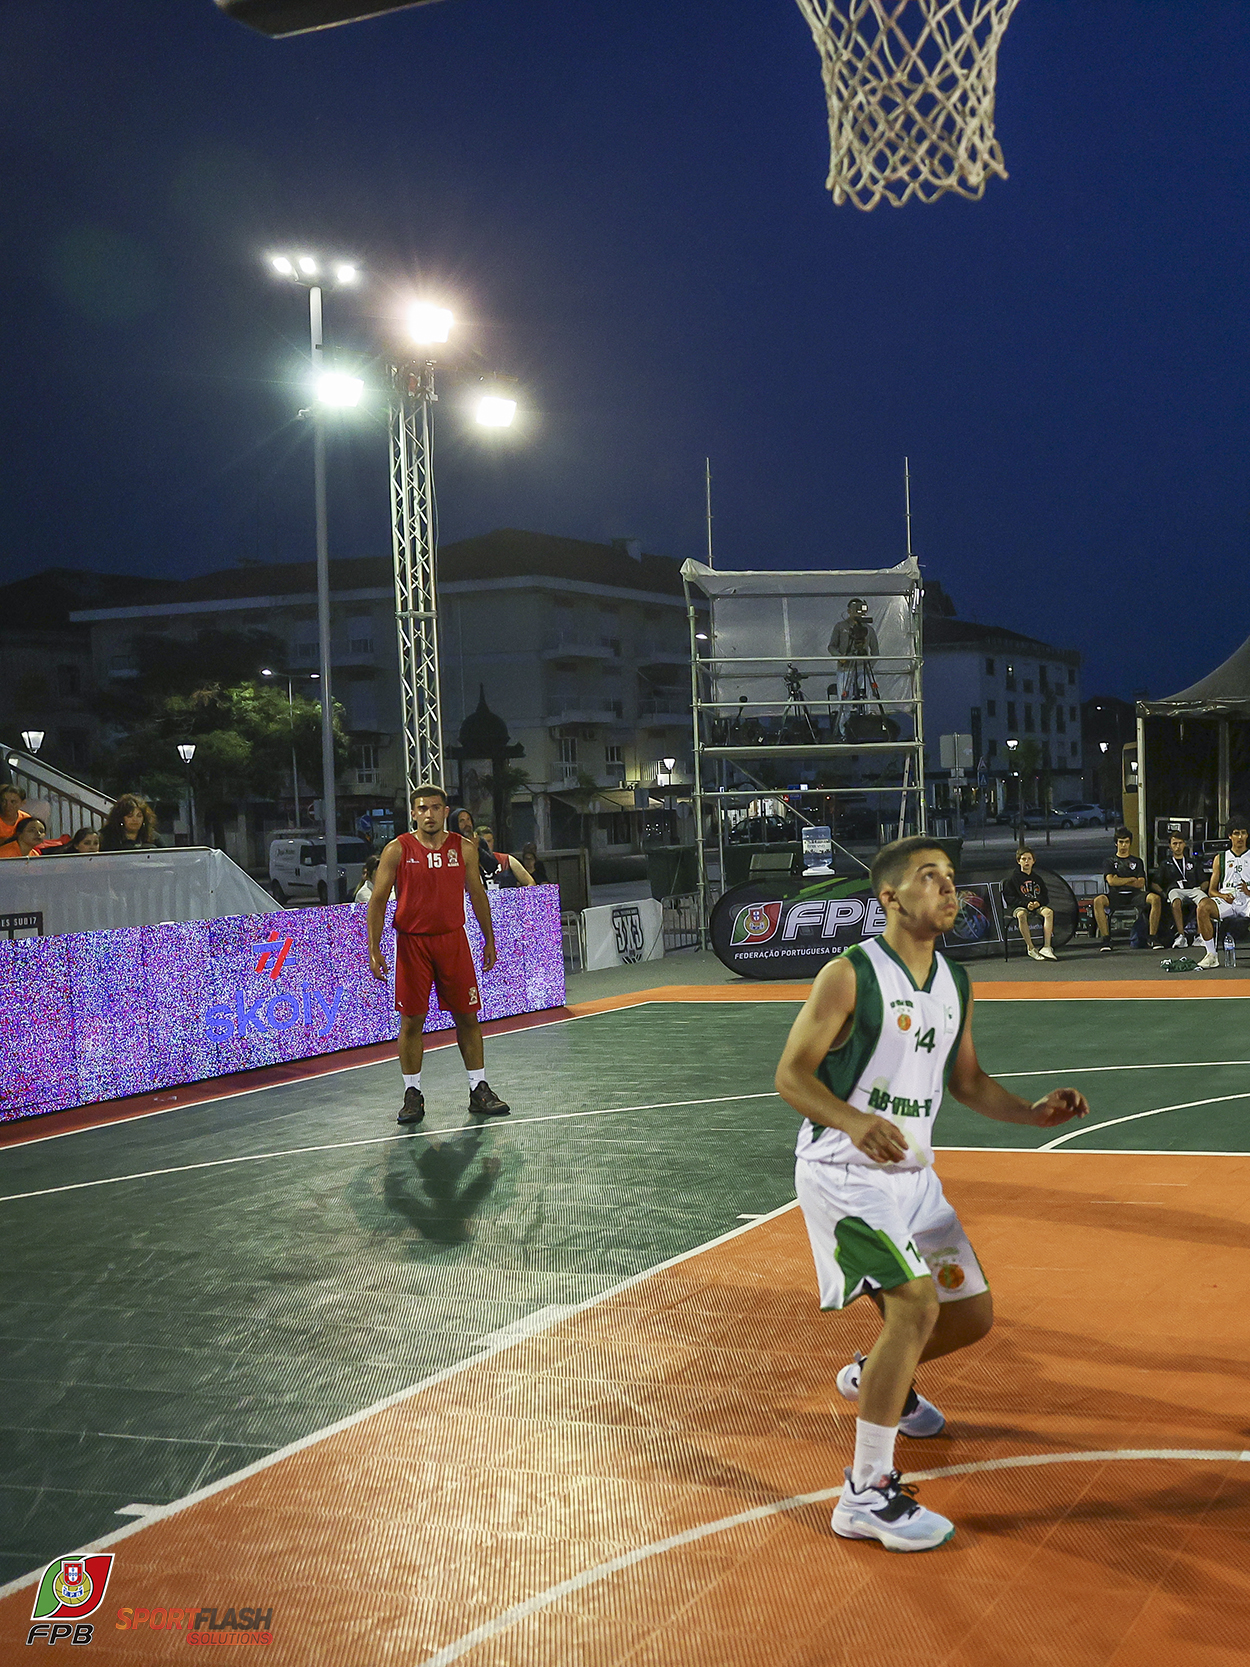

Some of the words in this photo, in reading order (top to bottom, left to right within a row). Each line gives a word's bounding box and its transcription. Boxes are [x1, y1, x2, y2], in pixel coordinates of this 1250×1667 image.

[426, 852, 442, 869] 15
[734, 949, 780, 960] FEDERAÇÃO
[781, 946, 830, 957] PORTUGUESA
[831, 946, 842, 954] DE
[914, 1026, 936, 1054] 14
